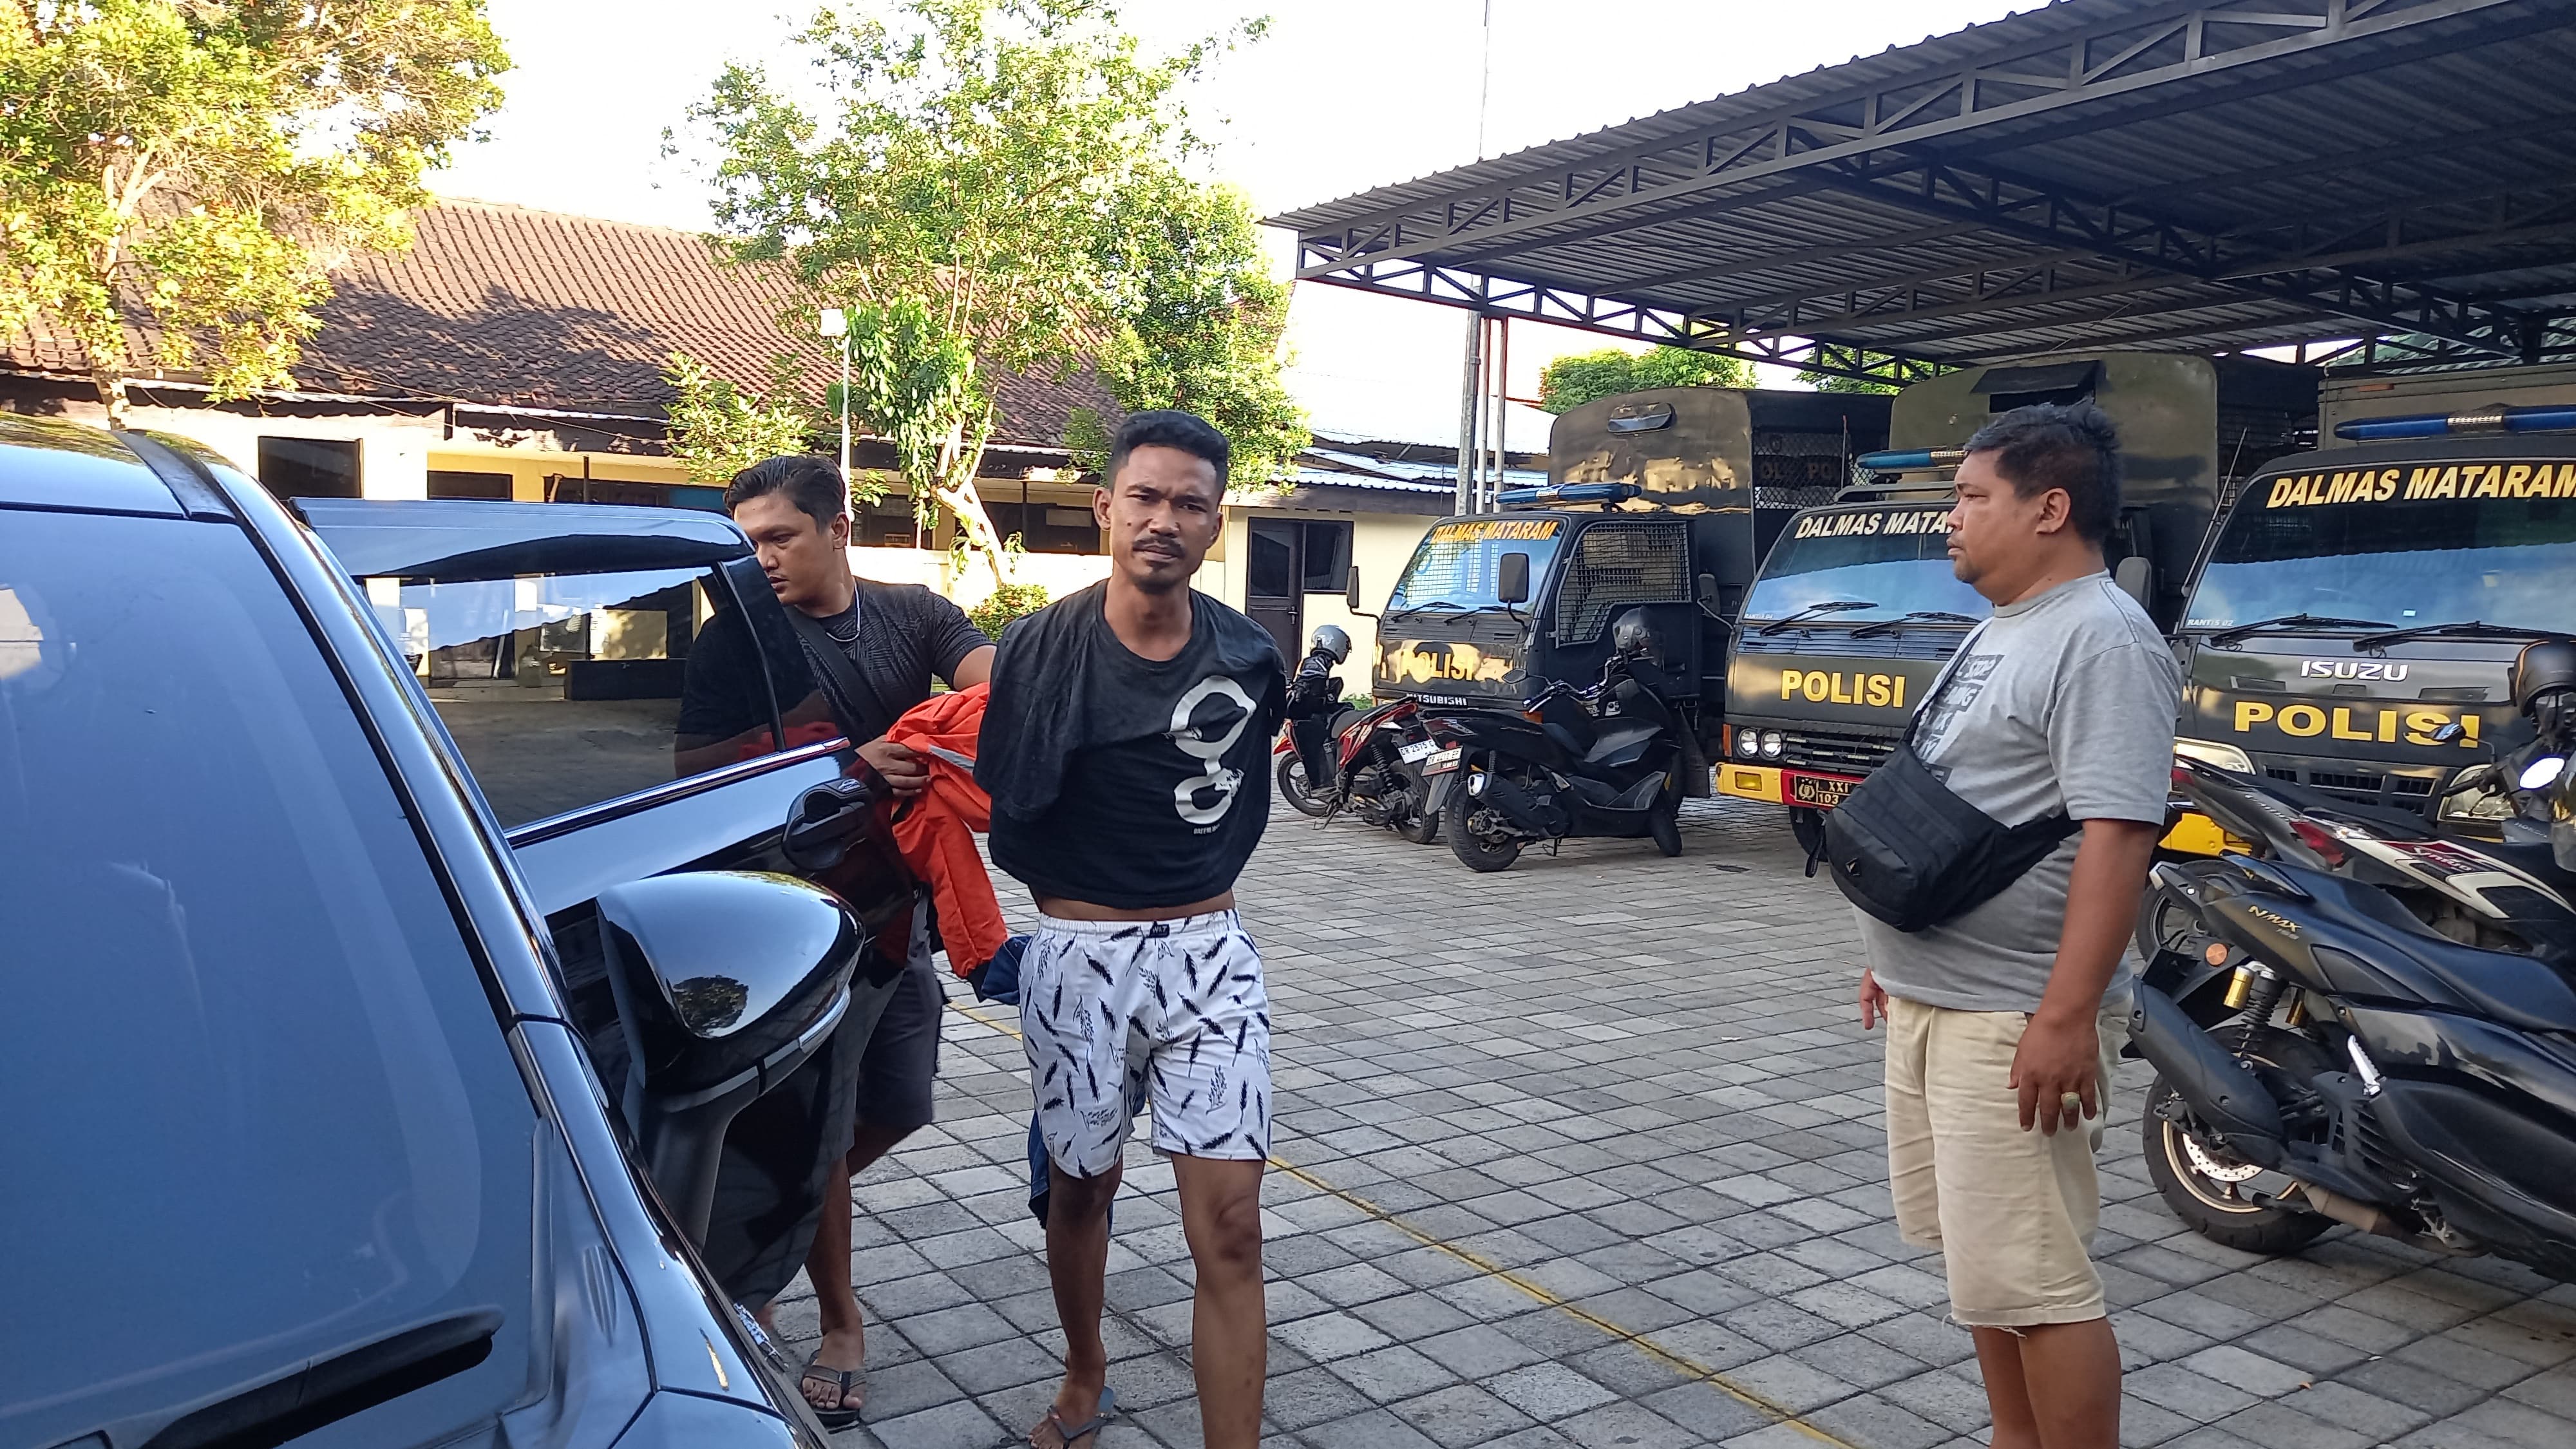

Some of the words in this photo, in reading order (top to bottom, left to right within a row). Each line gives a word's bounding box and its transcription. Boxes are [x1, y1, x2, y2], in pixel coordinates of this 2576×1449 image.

[2266, 468, 2400, 509] DALMAS
[2403, 464, 2576, 500] MATARAM
[1432, 522, 1484, 542] DALMAS
[1482, 520, 1558, 540] MATARAM
[1794, 513, 1882, 539] DALMAS
[1882, 511, 1955, 535] MATA
[1401, 650, 1475, 681] POLISI
[2300, 660, 2409, 681] ISUZU
[1781, 669, 1906, 708] POLISI
[2234, 701, 2481, 748] POLISI
